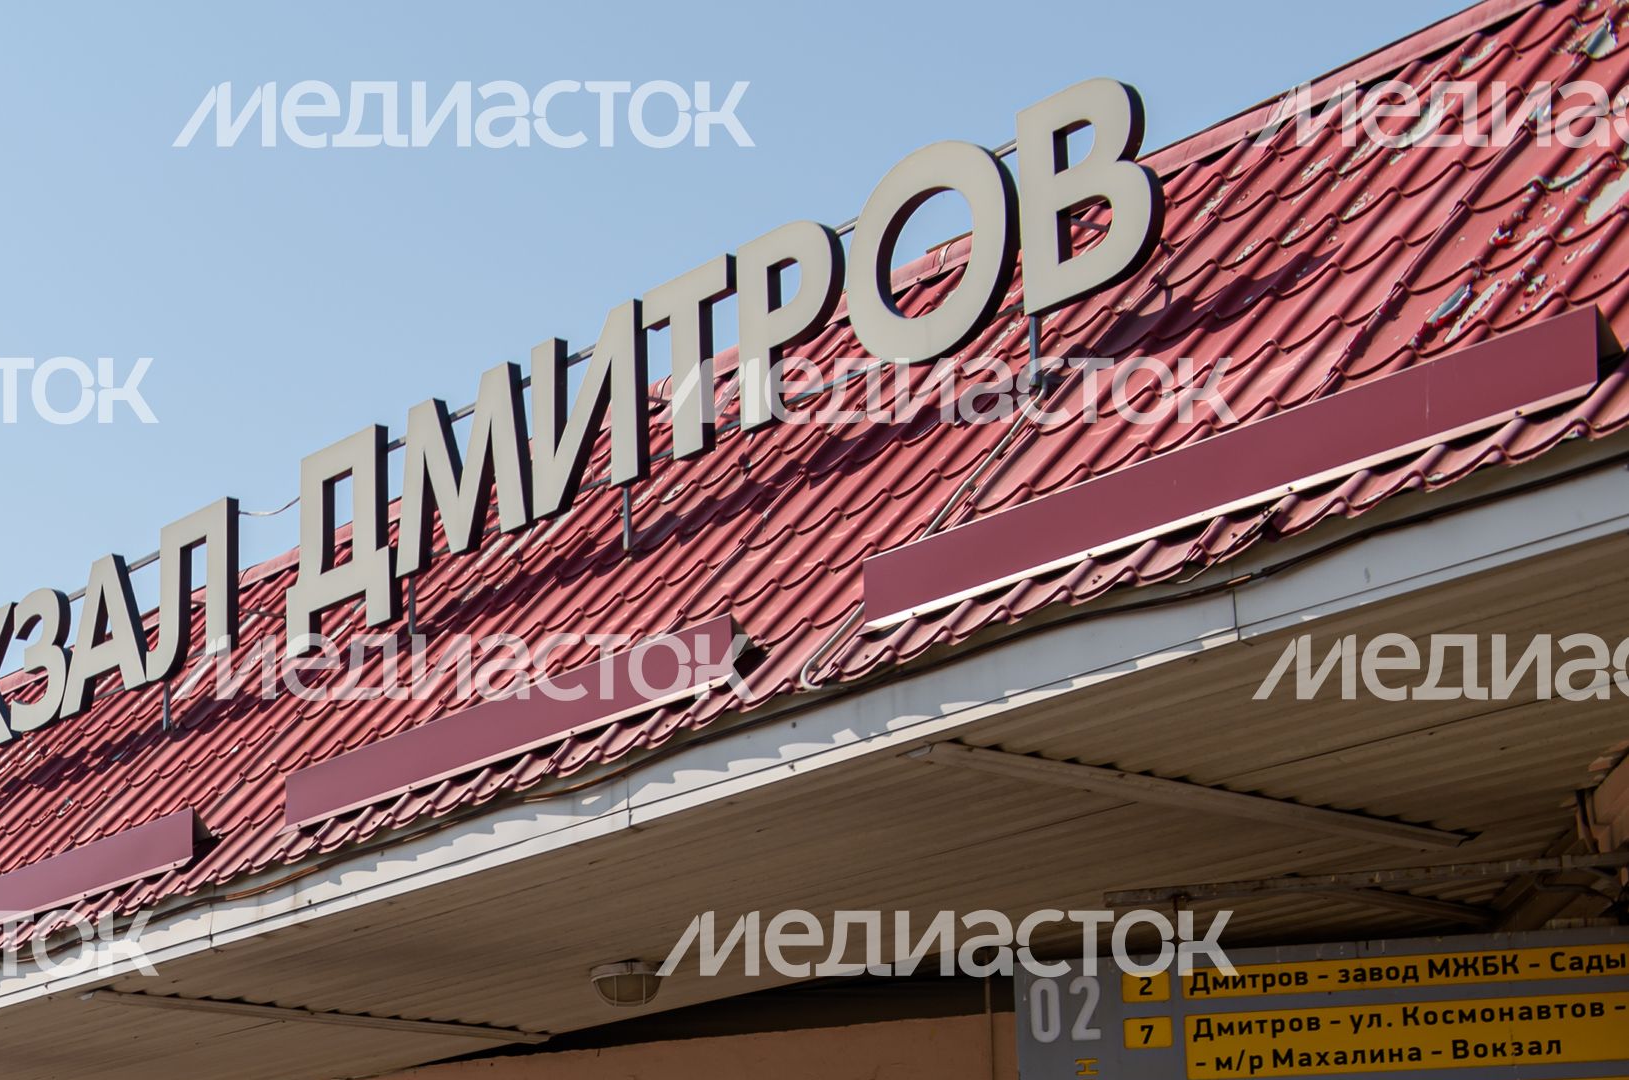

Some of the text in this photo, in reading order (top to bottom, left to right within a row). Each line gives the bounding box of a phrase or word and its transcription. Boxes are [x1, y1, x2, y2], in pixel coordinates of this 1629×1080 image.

[286, 78, 1165, 627] ДМИТРОВ
[1139, 976, 1153, 996] 2
[1189, 967, 1309, 995] Дмитров
[1337, 964, 1420, 984] завод
[1427, 954, 1520, 979] МЖБК
[1549, 952, 1626, 973] Сады
[1029, 976, 1102, 1043] 02
[1193, 1015, 1321, 1042] Дмитров
[1349, 1013, 1393, 1034] ул.
[1402, 1001, 1605, 1027] Космонавтов
[1140, 1025, 1154, 1045] 7
[1215, 1053, 1263, 1075] м/р
[1272, 1046, 1422, 1069] Махалина
[1451, 1039, 1562, 1060] Вокзал
